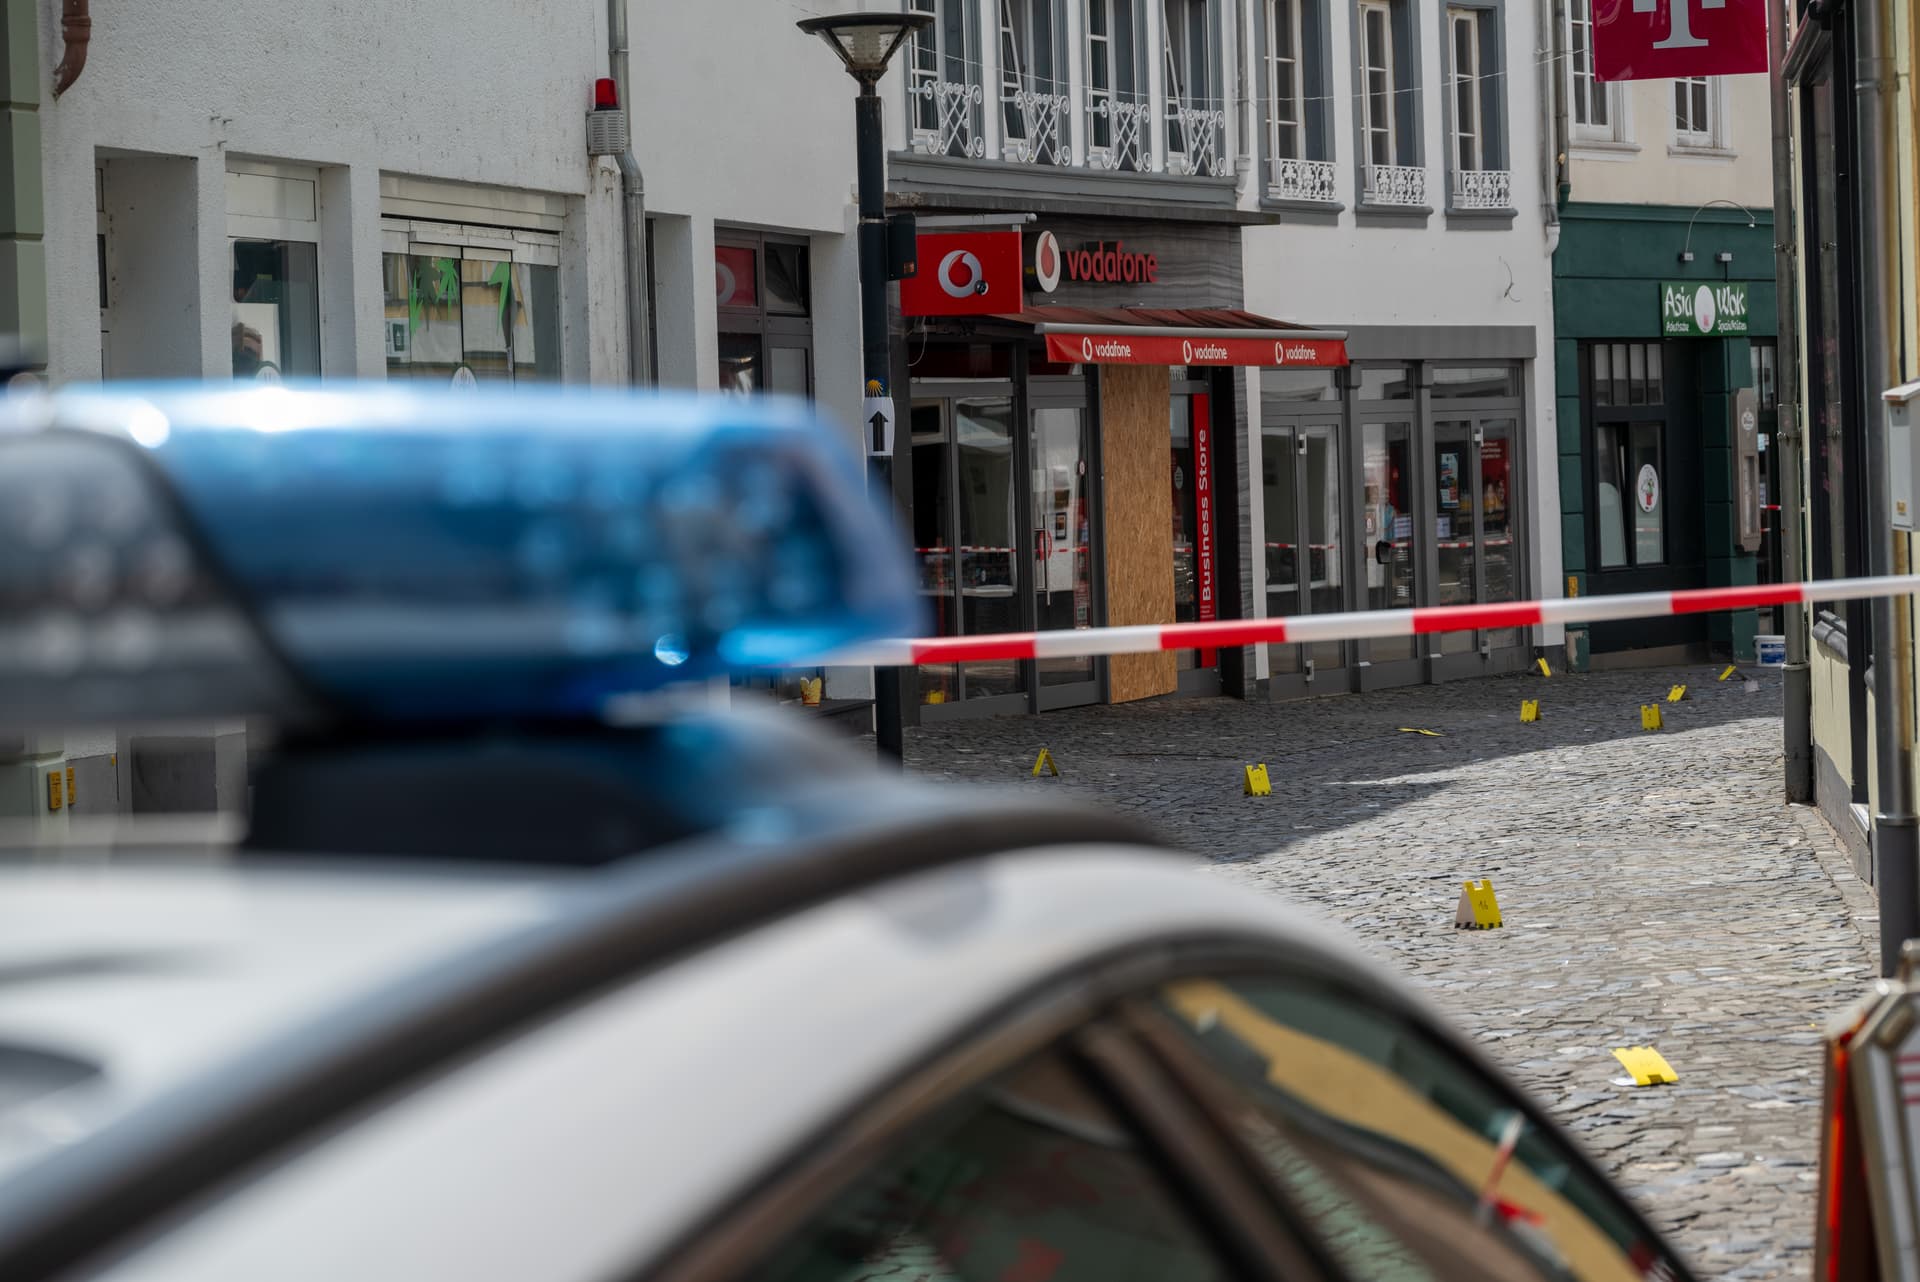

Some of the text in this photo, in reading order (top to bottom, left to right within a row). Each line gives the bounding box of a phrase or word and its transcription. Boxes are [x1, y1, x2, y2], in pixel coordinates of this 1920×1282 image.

[1068, 241, 1158, 282] vodafone
[1665, 285, 1746, 316] Asia Wok
[1095, 342, 1131, 358] vodafone
[1194, 344, 1228, 360] vodafone
[1285, 345, 1316, 361] vodafone
[1199, 429, 1207, 490] Store
[1202, 497, 1212, 601] Business
